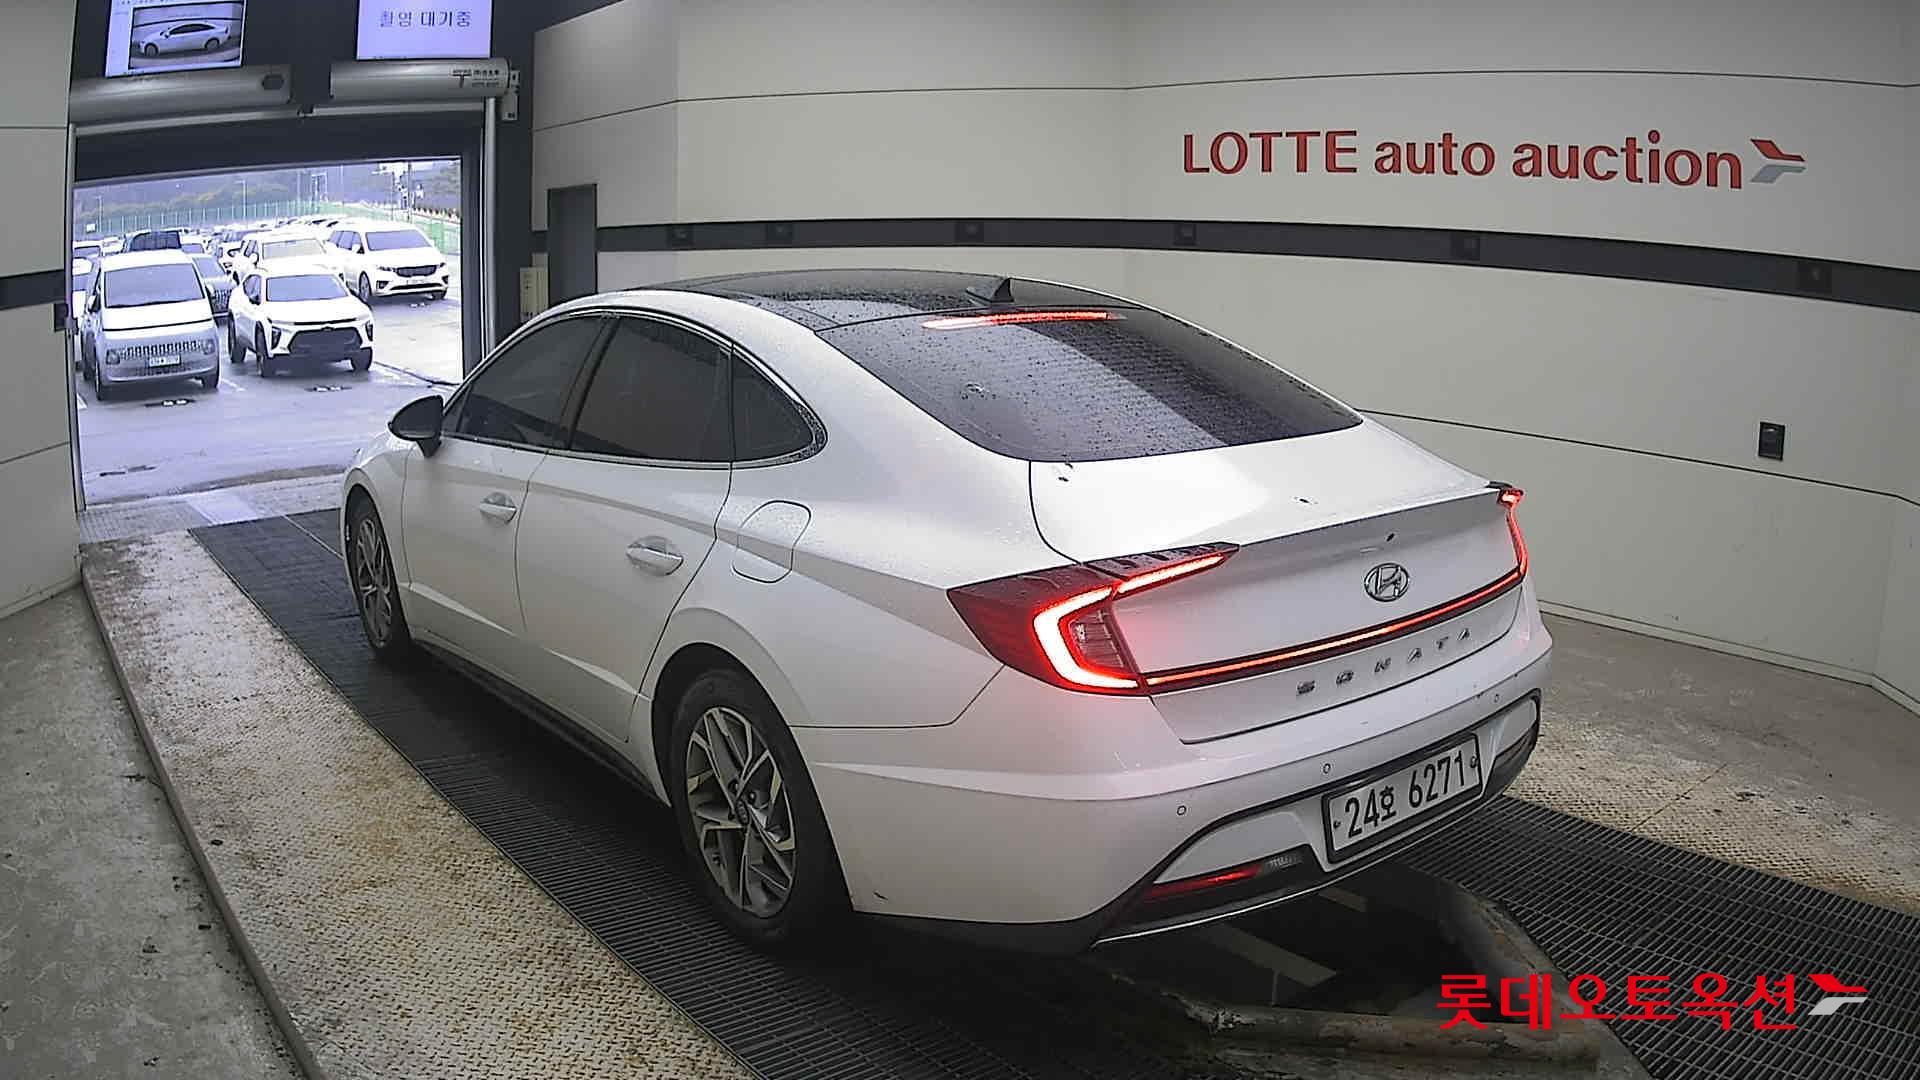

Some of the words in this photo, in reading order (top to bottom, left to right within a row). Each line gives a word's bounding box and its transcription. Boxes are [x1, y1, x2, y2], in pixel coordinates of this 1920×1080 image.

[421, 11, 471, 27] 대기중
[1183, 130, 1357, 174] LOTTE
[1374, 132, 1496, 176] auto
[1512, 129, 1742, 189] auction
[1345, 786, 1397, 839] 24호
[1408, 750, 1465, 809] 6271
